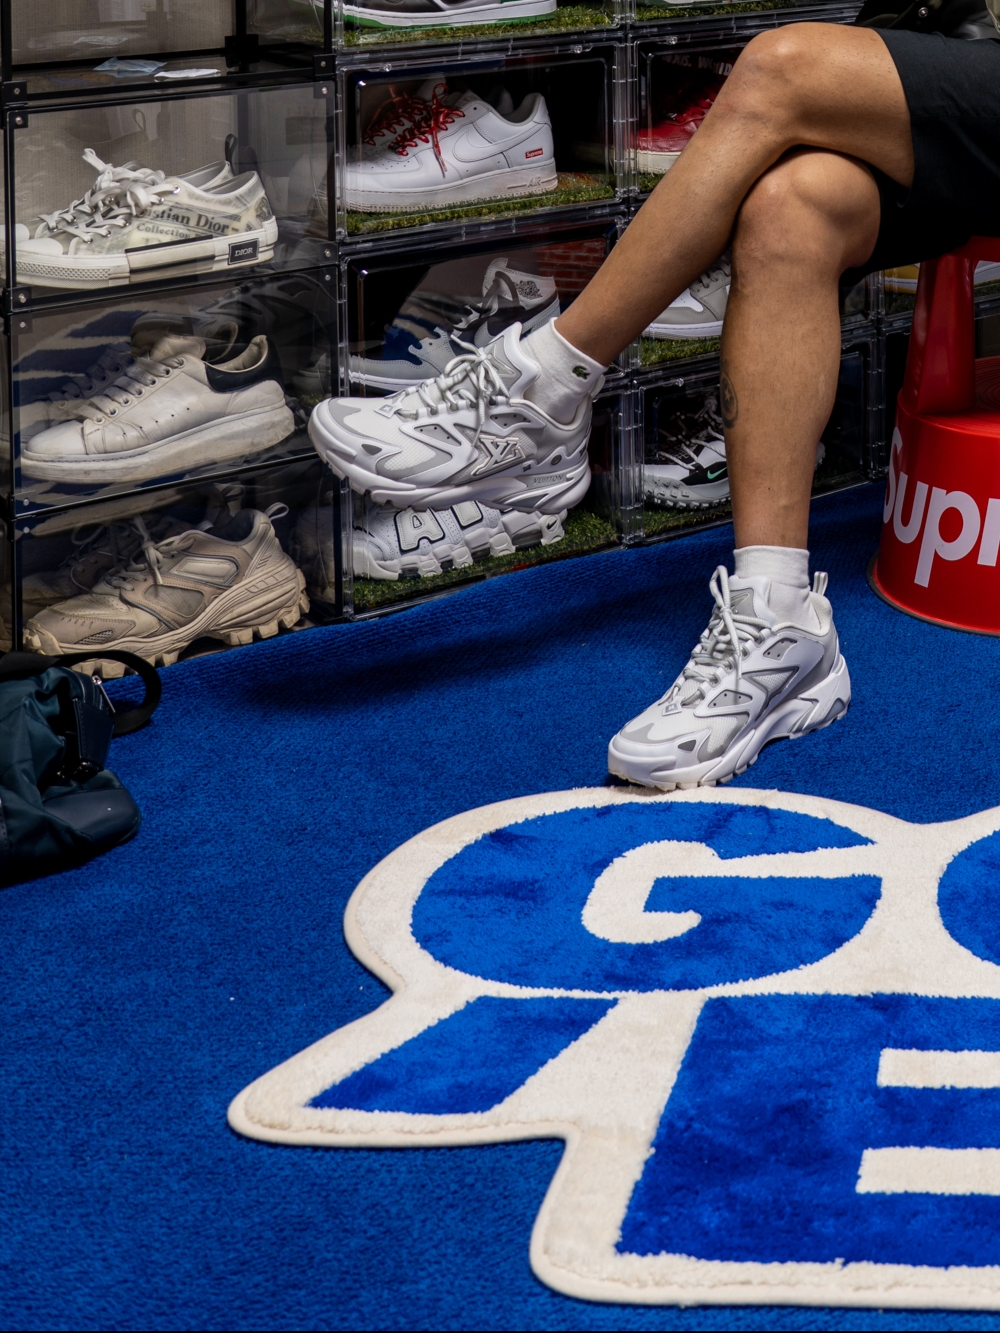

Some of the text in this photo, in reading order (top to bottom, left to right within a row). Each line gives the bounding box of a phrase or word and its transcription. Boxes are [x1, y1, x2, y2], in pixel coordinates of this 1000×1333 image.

[526, 149, 543, 158] Supreme
[526, 176, 542, 188] AIR
[141, 207, 229, 233] istian Dior
[234, 247, 253, 257] DIOR
[533, 474, 564, 485] VUITTON
